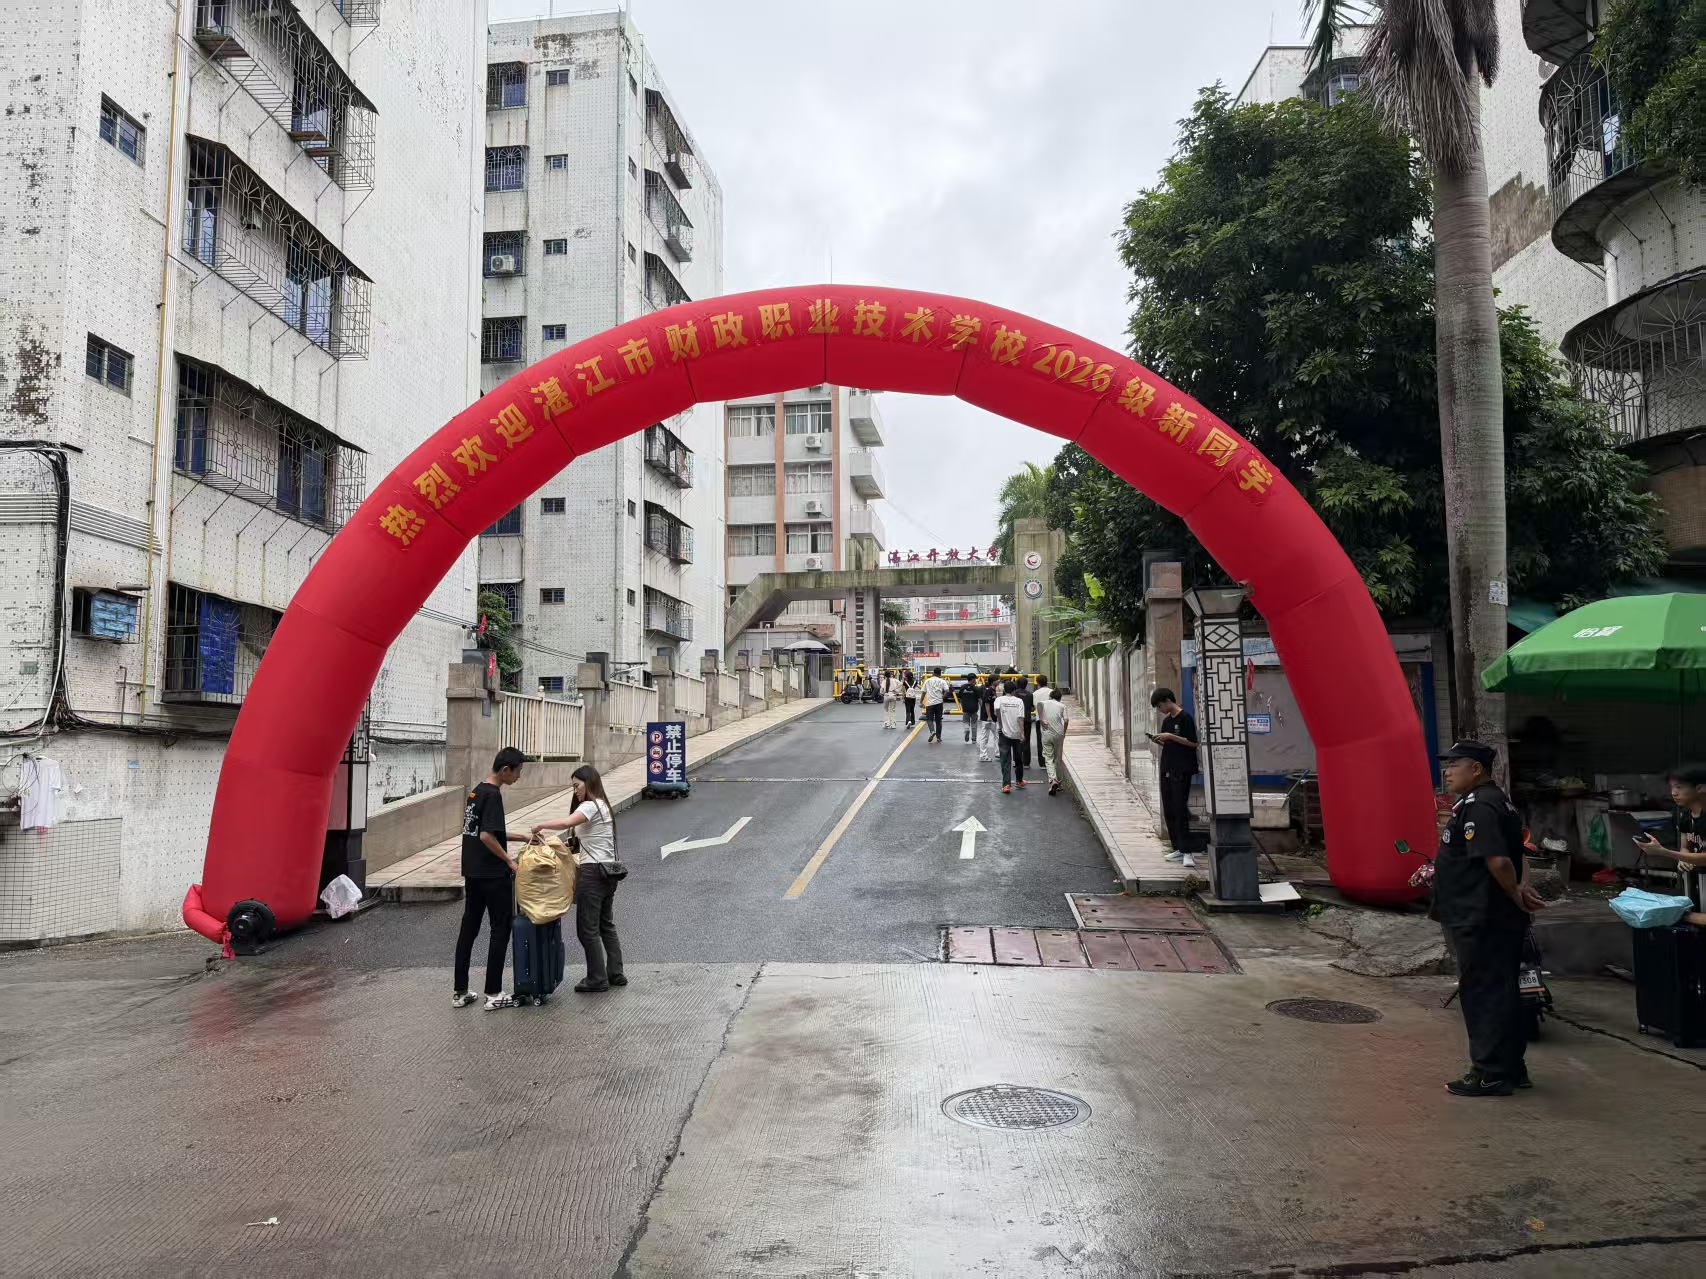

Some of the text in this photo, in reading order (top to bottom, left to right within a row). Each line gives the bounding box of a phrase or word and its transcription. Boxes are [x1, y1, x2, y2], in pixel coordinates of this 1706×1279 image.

[379, 298, 1273, 545] 热烈欢迎湛江市财政职业技术学校2026级新同学
[888, 544, 999, 564] 湛江开放大学
[665, 724, 682, 783] 禁止停车
